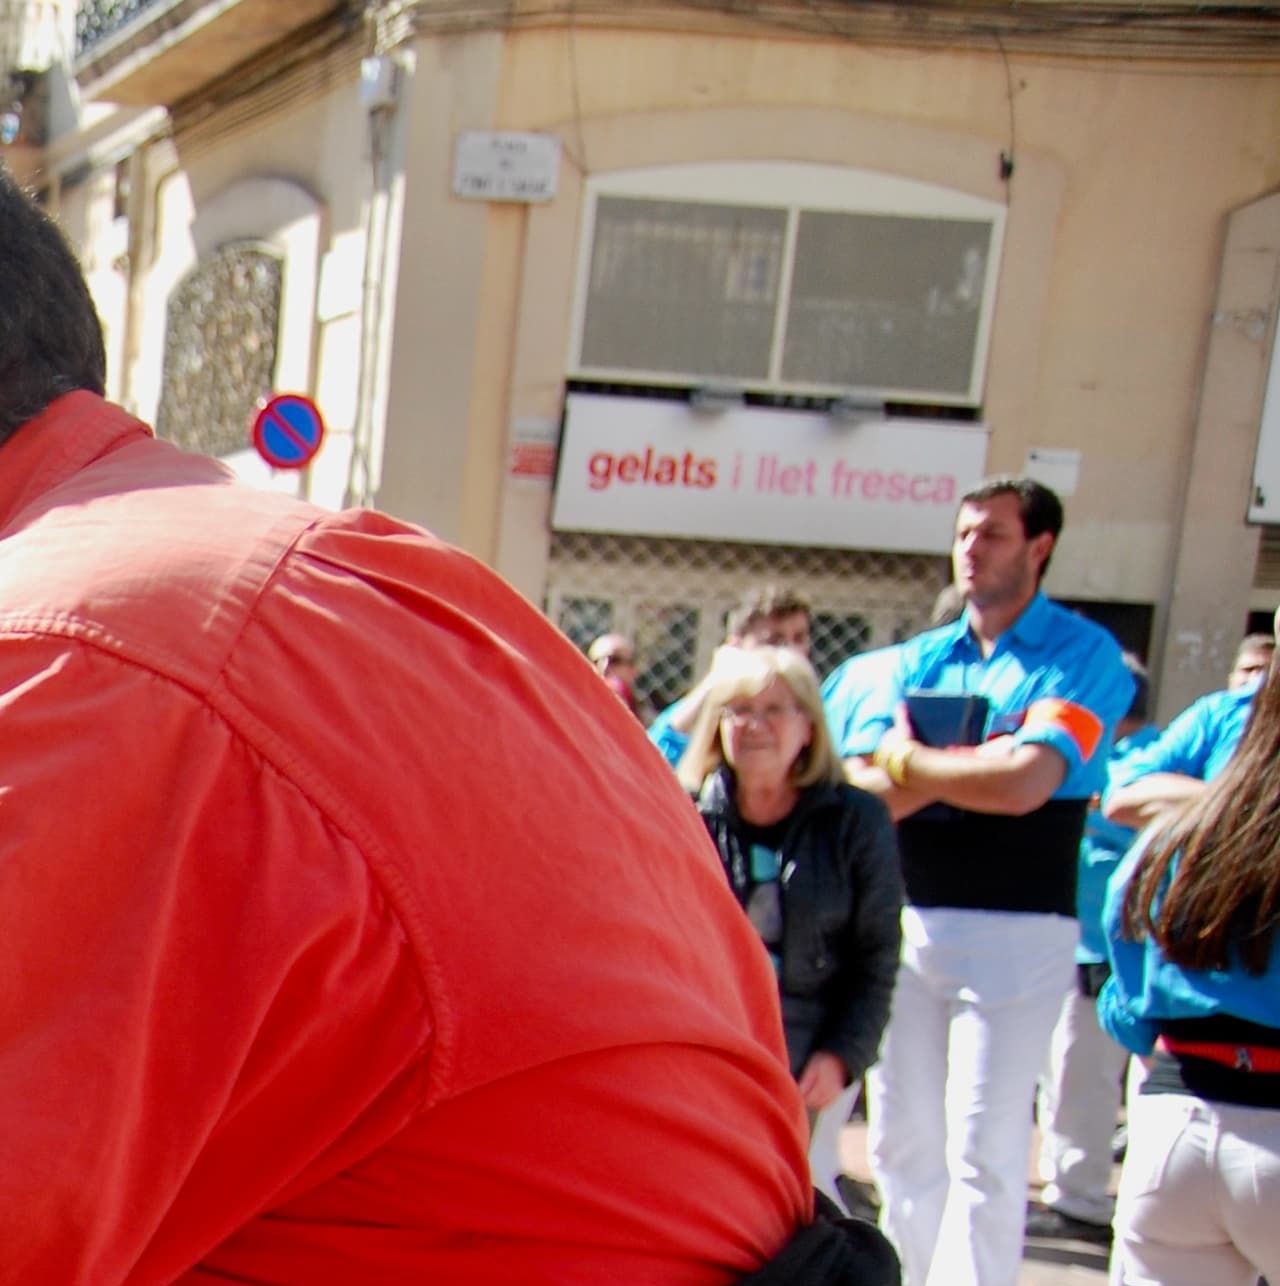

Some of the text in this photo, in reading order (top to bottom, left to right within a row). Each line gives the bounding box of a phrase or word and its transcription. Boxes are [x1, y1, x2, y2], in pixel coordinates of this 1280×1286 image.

[586, 445, 718, 493] gelats
[731, 453, 740, 490] i
[755, 454, 817, 496] llet
[831, 458, 958, 504] fresca
